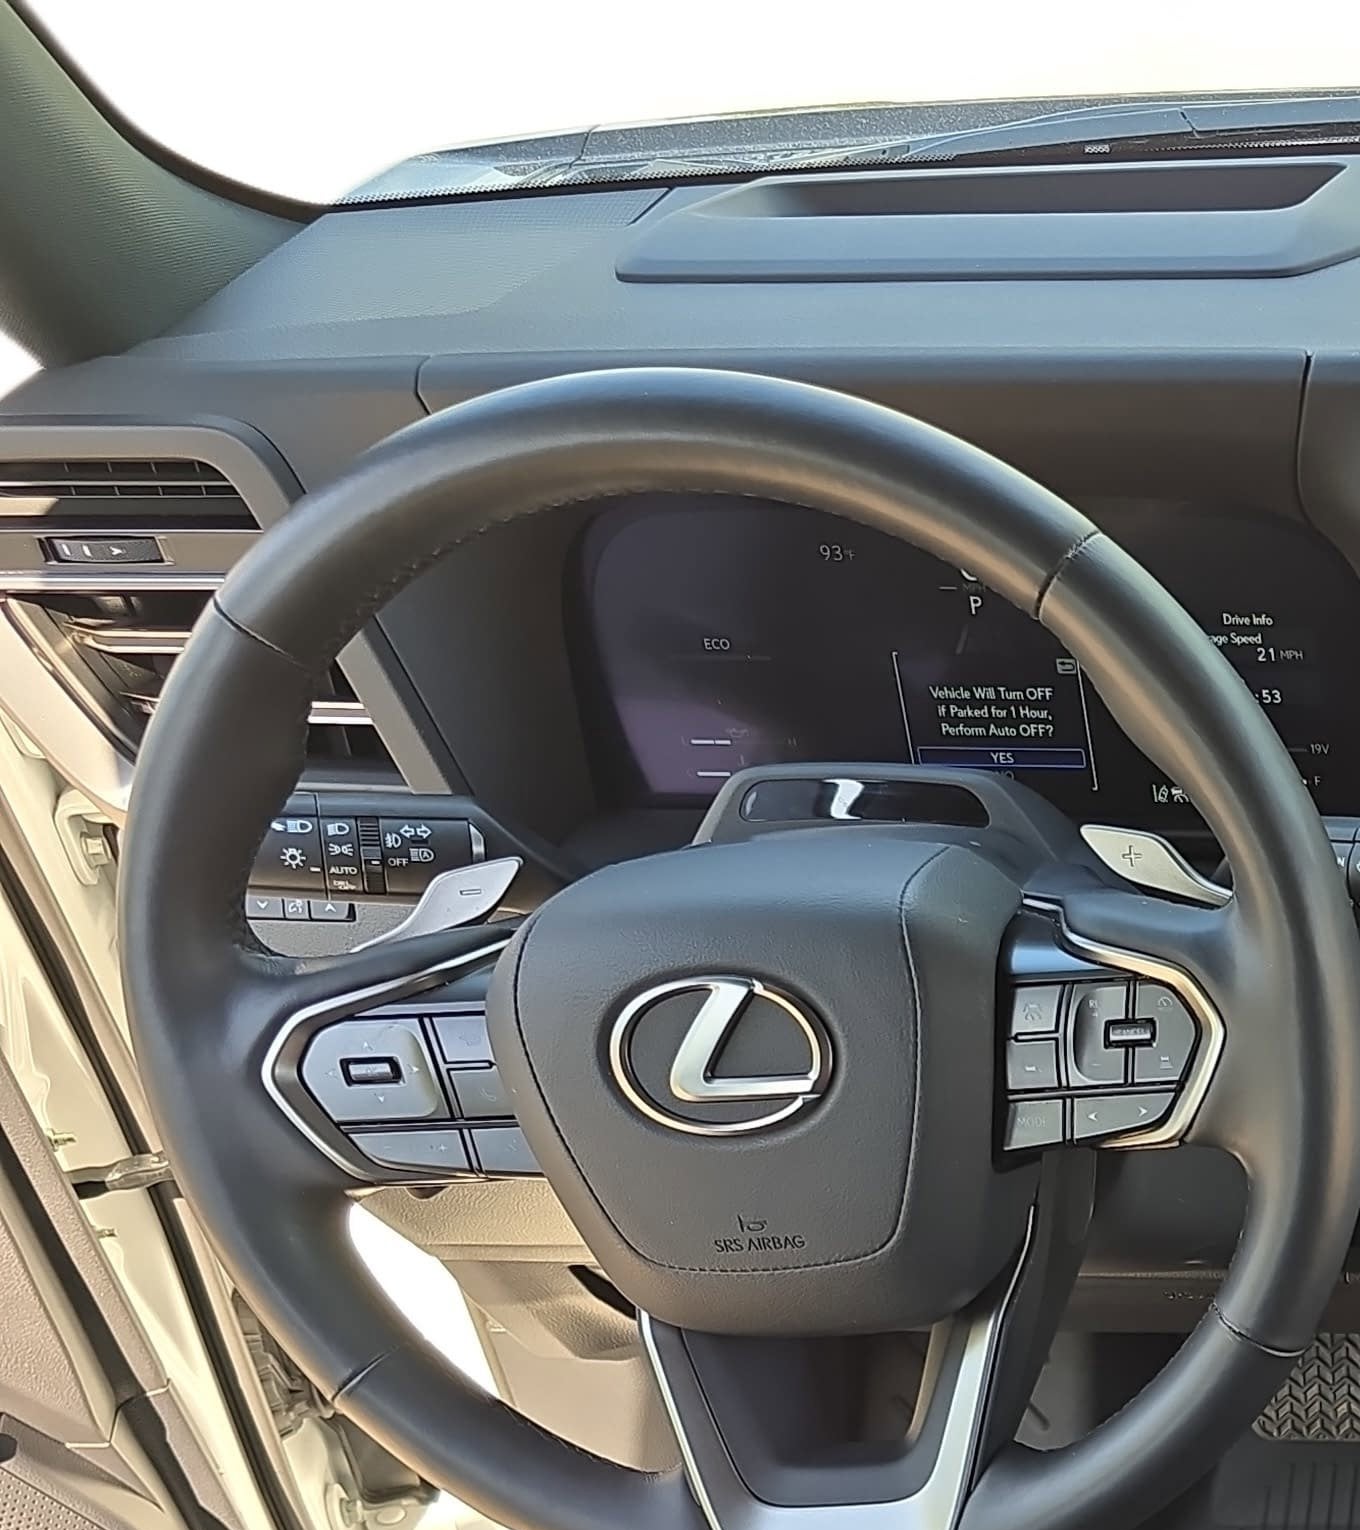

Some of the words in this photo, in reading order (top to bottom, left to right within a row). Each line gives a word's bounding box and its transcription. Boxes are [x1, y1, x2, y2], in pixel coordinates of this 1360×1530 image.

[969, 595, 983, 615] P
[1223, 613, 1250, 626] Drive
[1252, 614, 1274, 626] Info
[704, 637, 730, 650] ECO
[1231, 633, 1262, 645] Speed
[1257, 648, 1275, 662] 21
[929, 686, 971, 700] Vehicle
[973, 687, 996, 700] Will
[999, 687, 1024, 700] Turn
[1026, 688, 1053, 700] OFF
[950, 705, 989, 718] Parked
[991, 706, 1007, 718] for
[1020, 707, 1052, 720] Hour,
[941, 723, 986, 736] Perform
[989, 724, 1017, 736] Auto
[1019, 725, 1054, 737] OFF?
[1310, 744, 1329, 754] 19V
[990, 752, 1015, 764] YES
[387, 858, 408, 867] OFF
[329, 866, 358, 875] AUTO
[714, 1239, 745, 1252] SRS
[748, 1235, 806, 1251] AIRBAG
